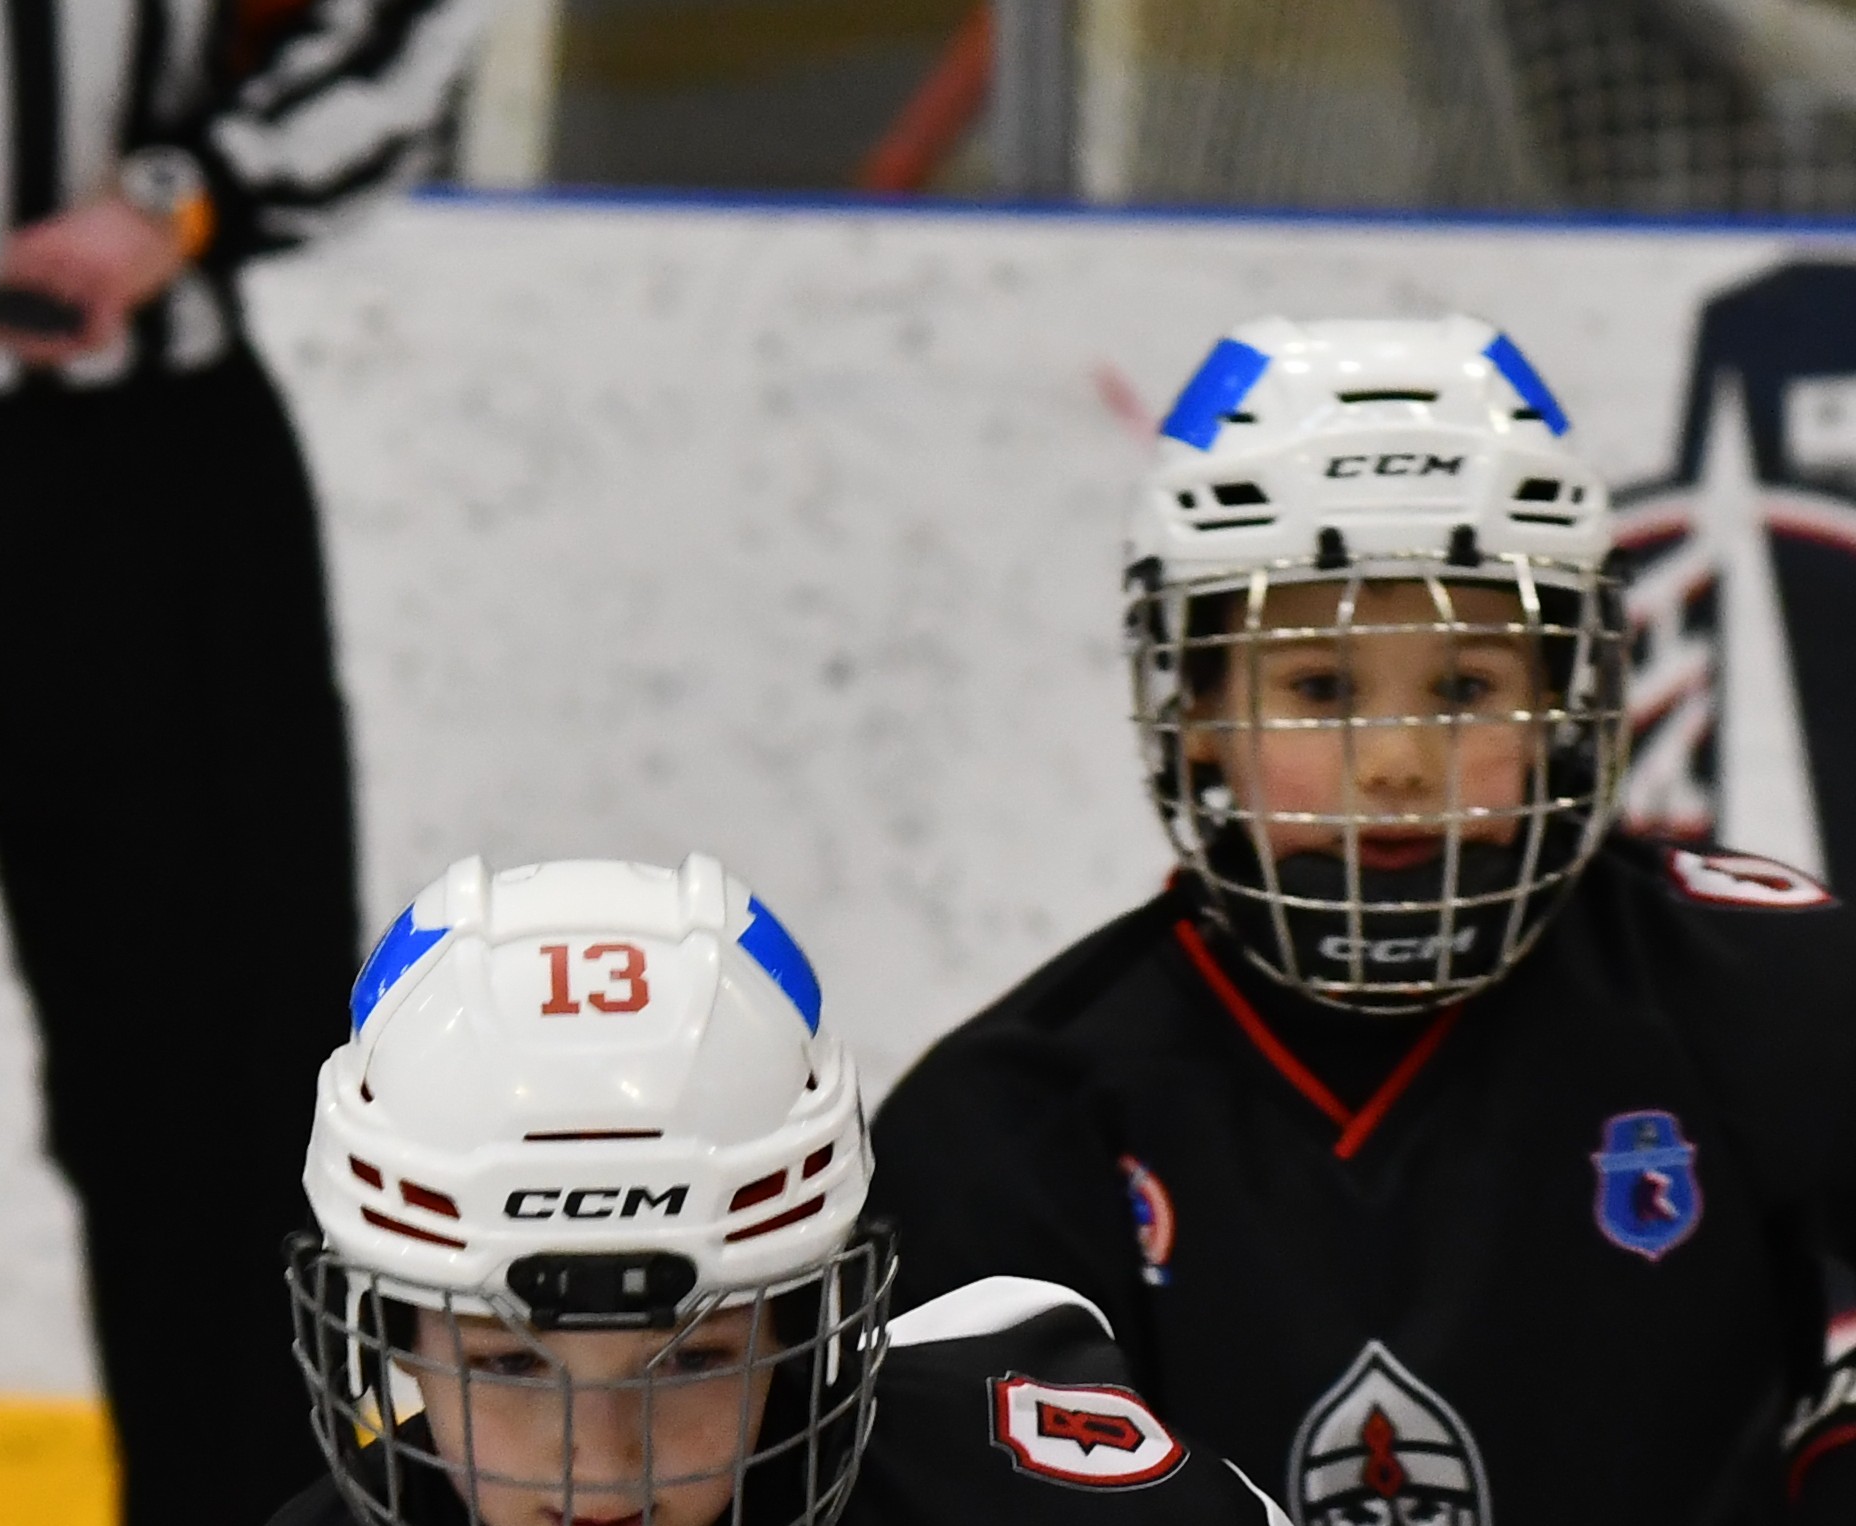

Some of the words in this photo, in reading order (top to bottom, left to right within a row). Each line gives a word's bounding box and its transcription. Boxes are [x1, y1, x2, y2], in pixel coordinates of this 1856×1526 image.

[1324, 452, 1465, 480] CCM
[539, 943, 651, 1017] 13
[503, 1184, 691, 1220] CCM
